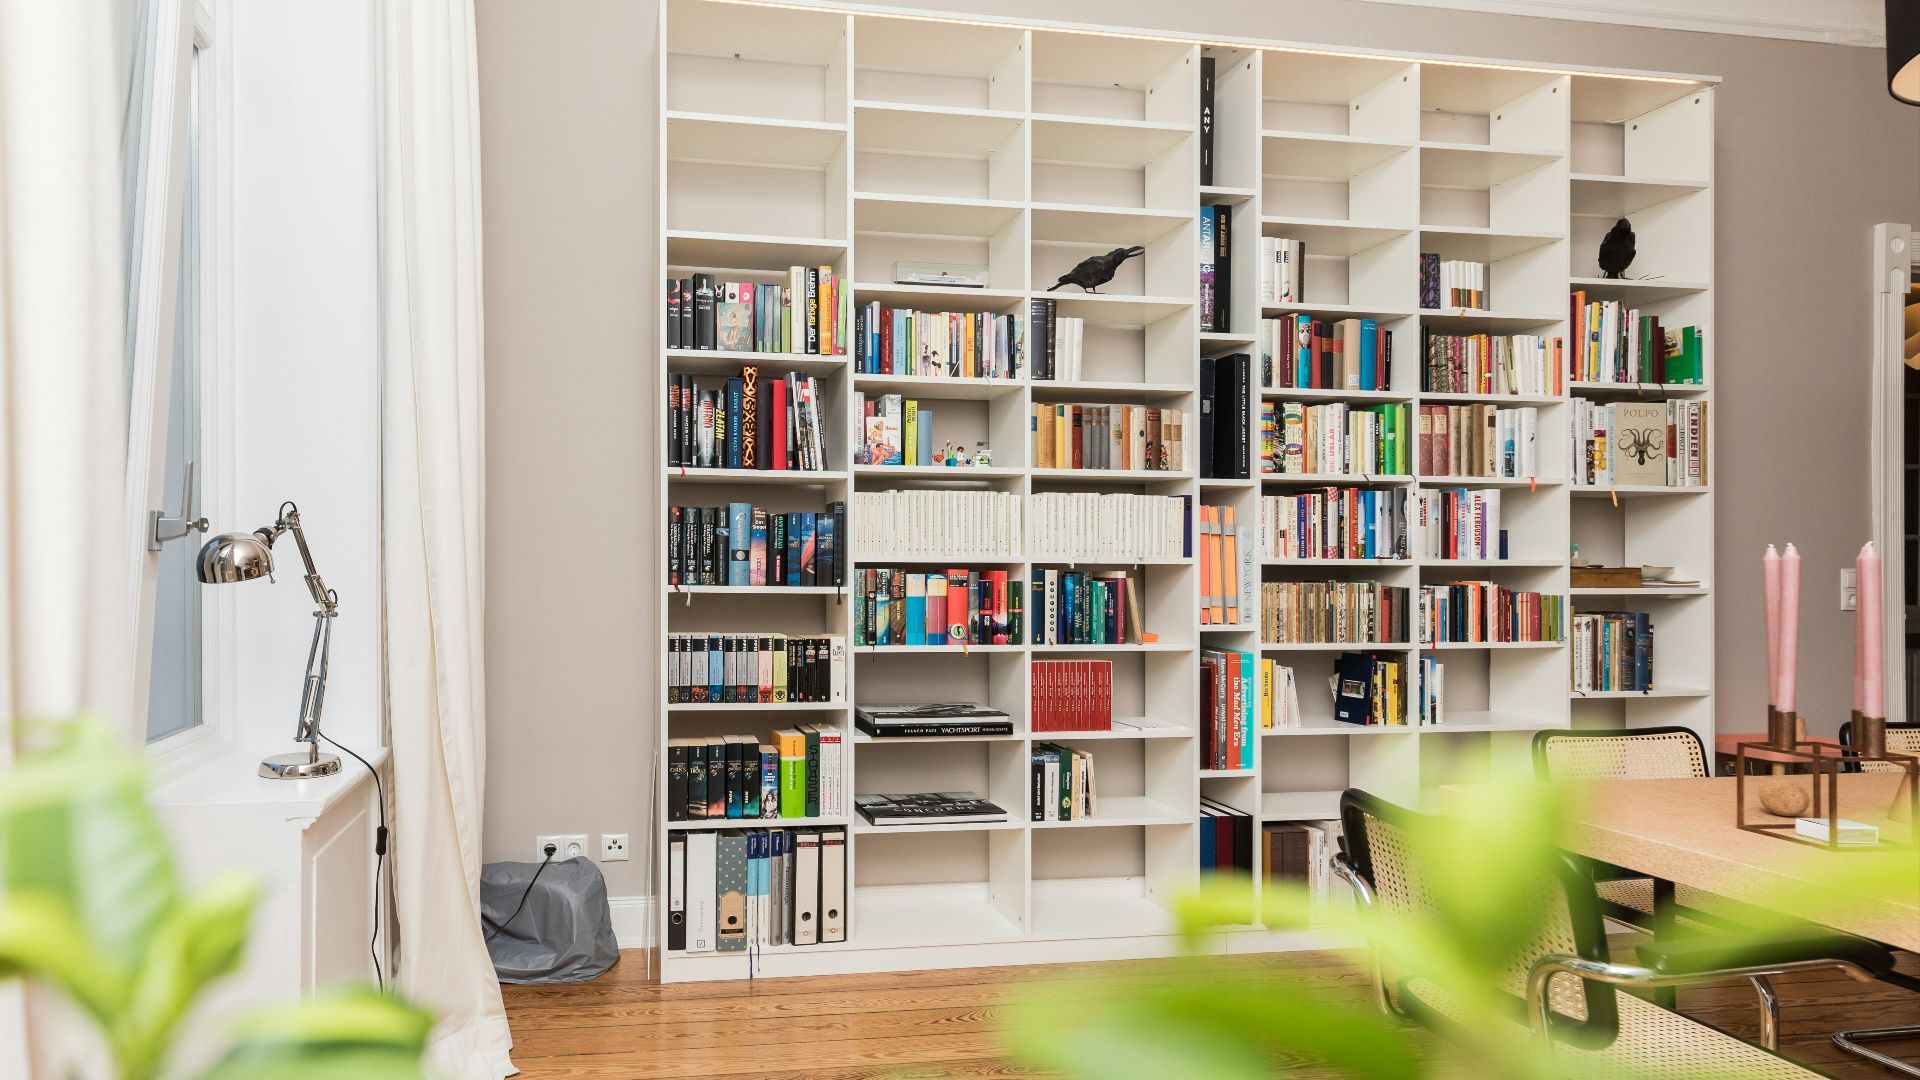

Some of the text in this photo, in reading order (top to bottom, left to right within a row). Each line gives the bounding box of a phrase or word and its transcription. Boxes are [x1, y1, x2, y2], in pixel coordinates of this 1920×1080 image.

[1203, 106, 1211, 133] ANY
[807, 271, 817, 342] Der farbige Brehm
[1623, 409, 1659, 418] POLPO
[1690, 412, 1699, 458] INDIEN
[1219, 675, 1227, 699] McCurry
[1240, 677, 1249, 725] Advertising
[941, 726, 982, 734] YACHTSPORT
